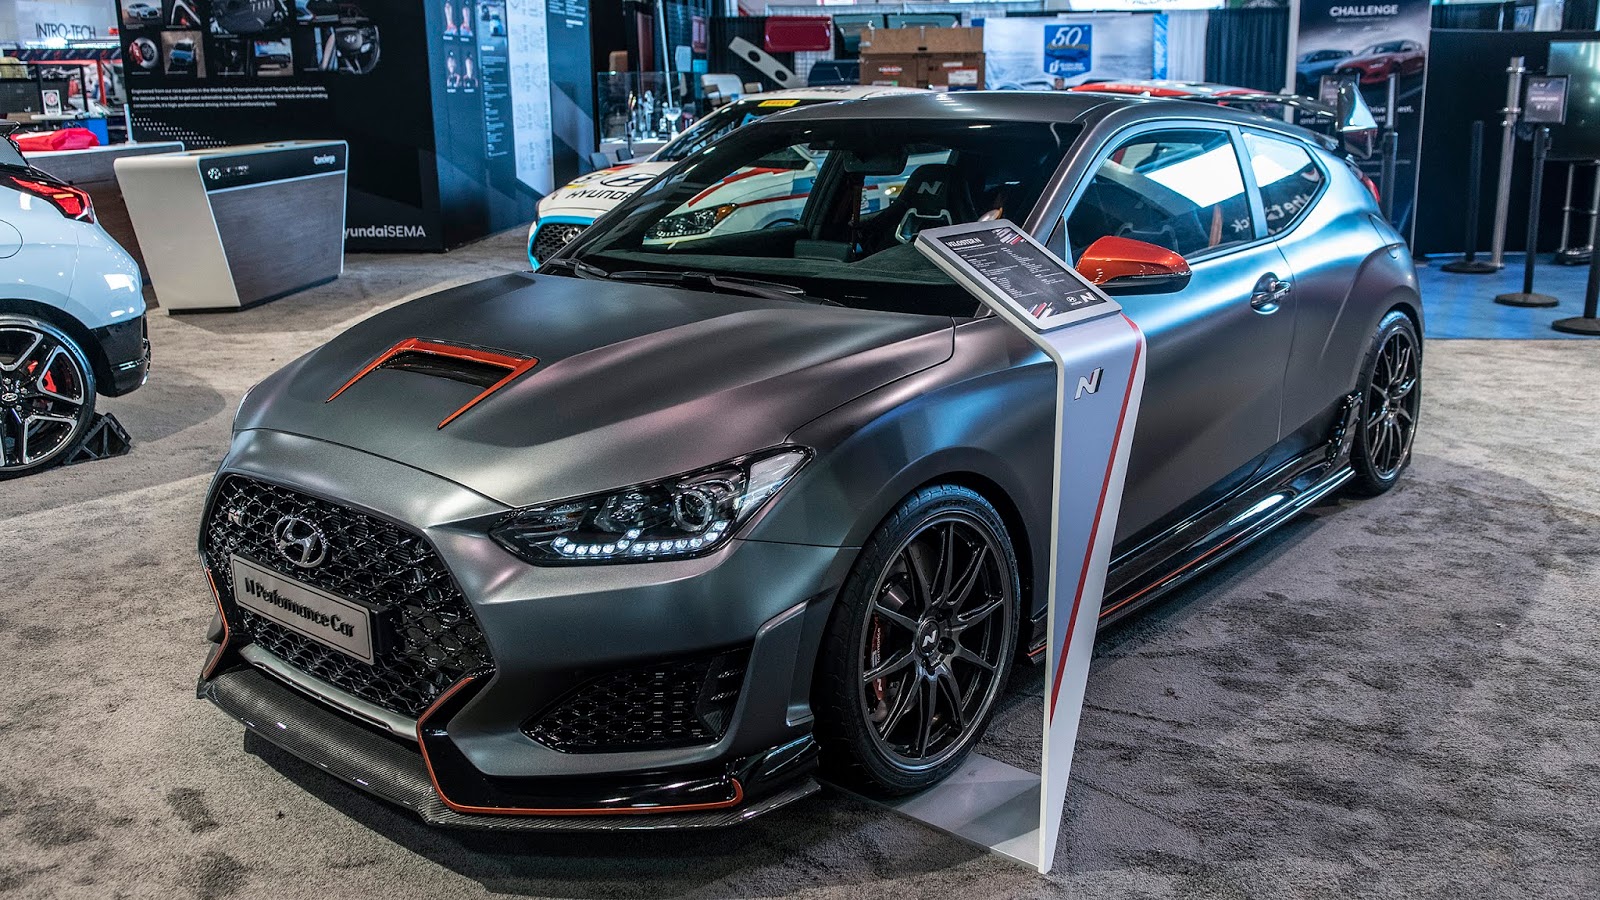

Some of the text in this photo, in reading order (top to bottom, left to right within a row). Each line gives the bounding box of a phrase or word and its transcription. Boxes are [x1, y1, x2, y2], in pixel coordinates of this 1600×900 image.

[1330, 5, 1399, 16] CHALLENGE
[1052, 26, 1083, 47] 50
[565, 189, 634, 201] HYUNDA
[344, 225, 426, 240] yundaiSEMA
[1074, 367, 1104, 400] N
[245, 577, 355, 638] N Performance Car
[922, 629, 937, 648] N
